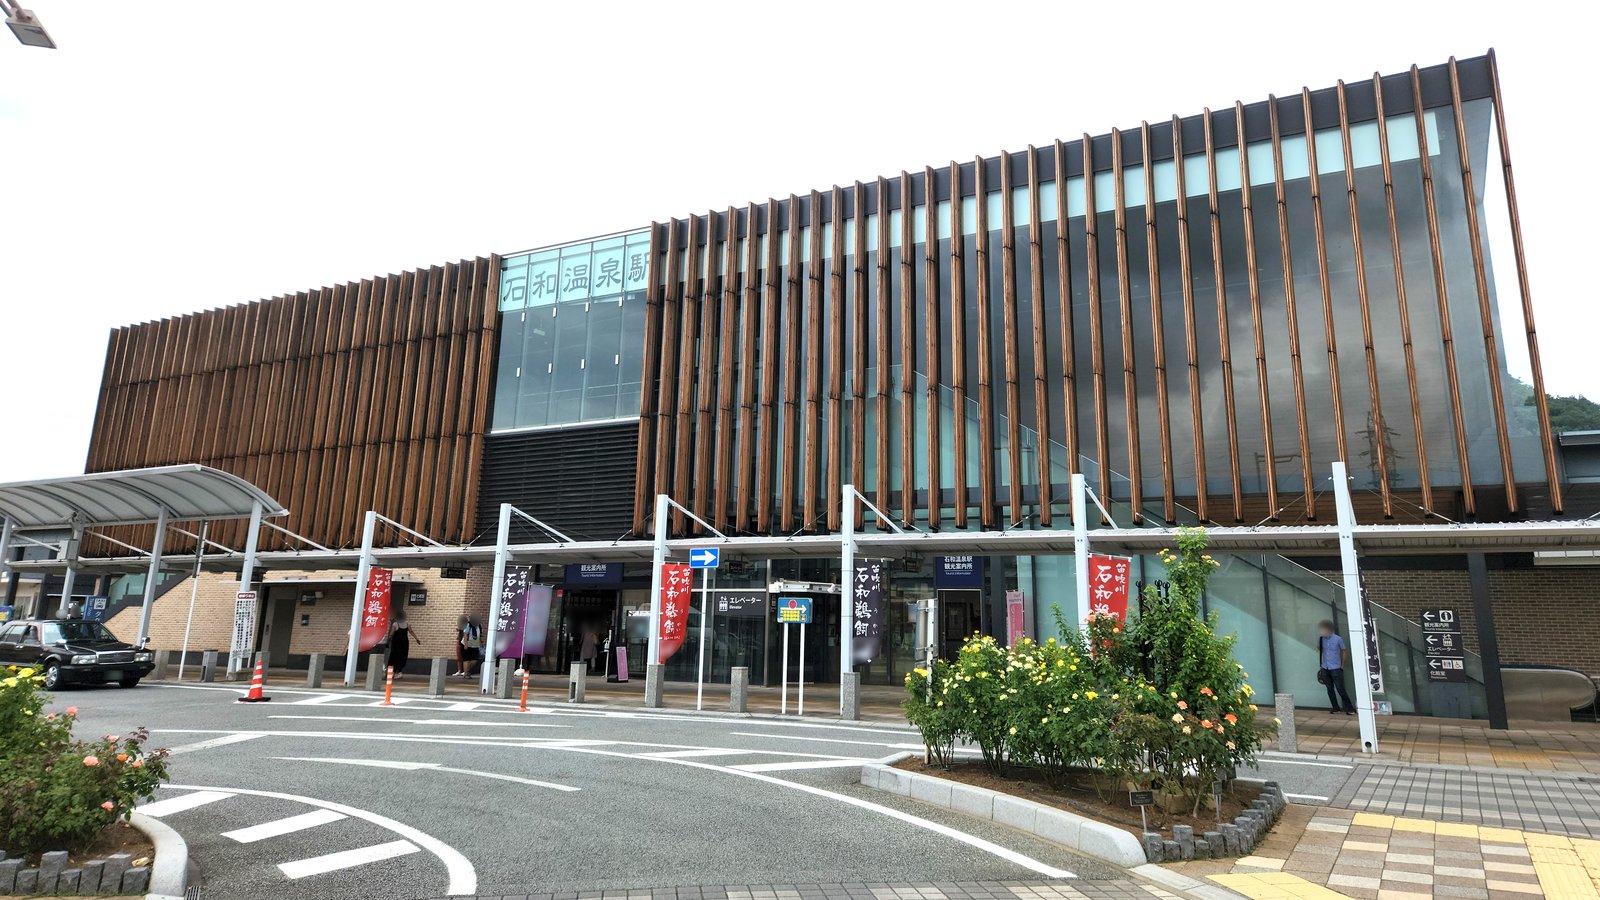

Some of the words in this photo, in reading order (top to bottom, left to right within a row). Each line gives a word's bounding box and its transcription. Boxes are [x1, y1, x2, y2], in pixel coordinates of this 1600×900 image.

[503, 252, 650, 302] 石和温泉駅
[517, 570, 528, 596] 笛吹川
[680, 568, 691, 595] 笛吹川
[871, 564, 881, 592] 笛吹川
[1114, 563, 1127, 595] 笛吹川
[497, 573, 517, 632] 石和鵜飼
[663, 570, 680, 634] 石和鵜飼
[854, 567, 872, 637] 石和鵜飼
